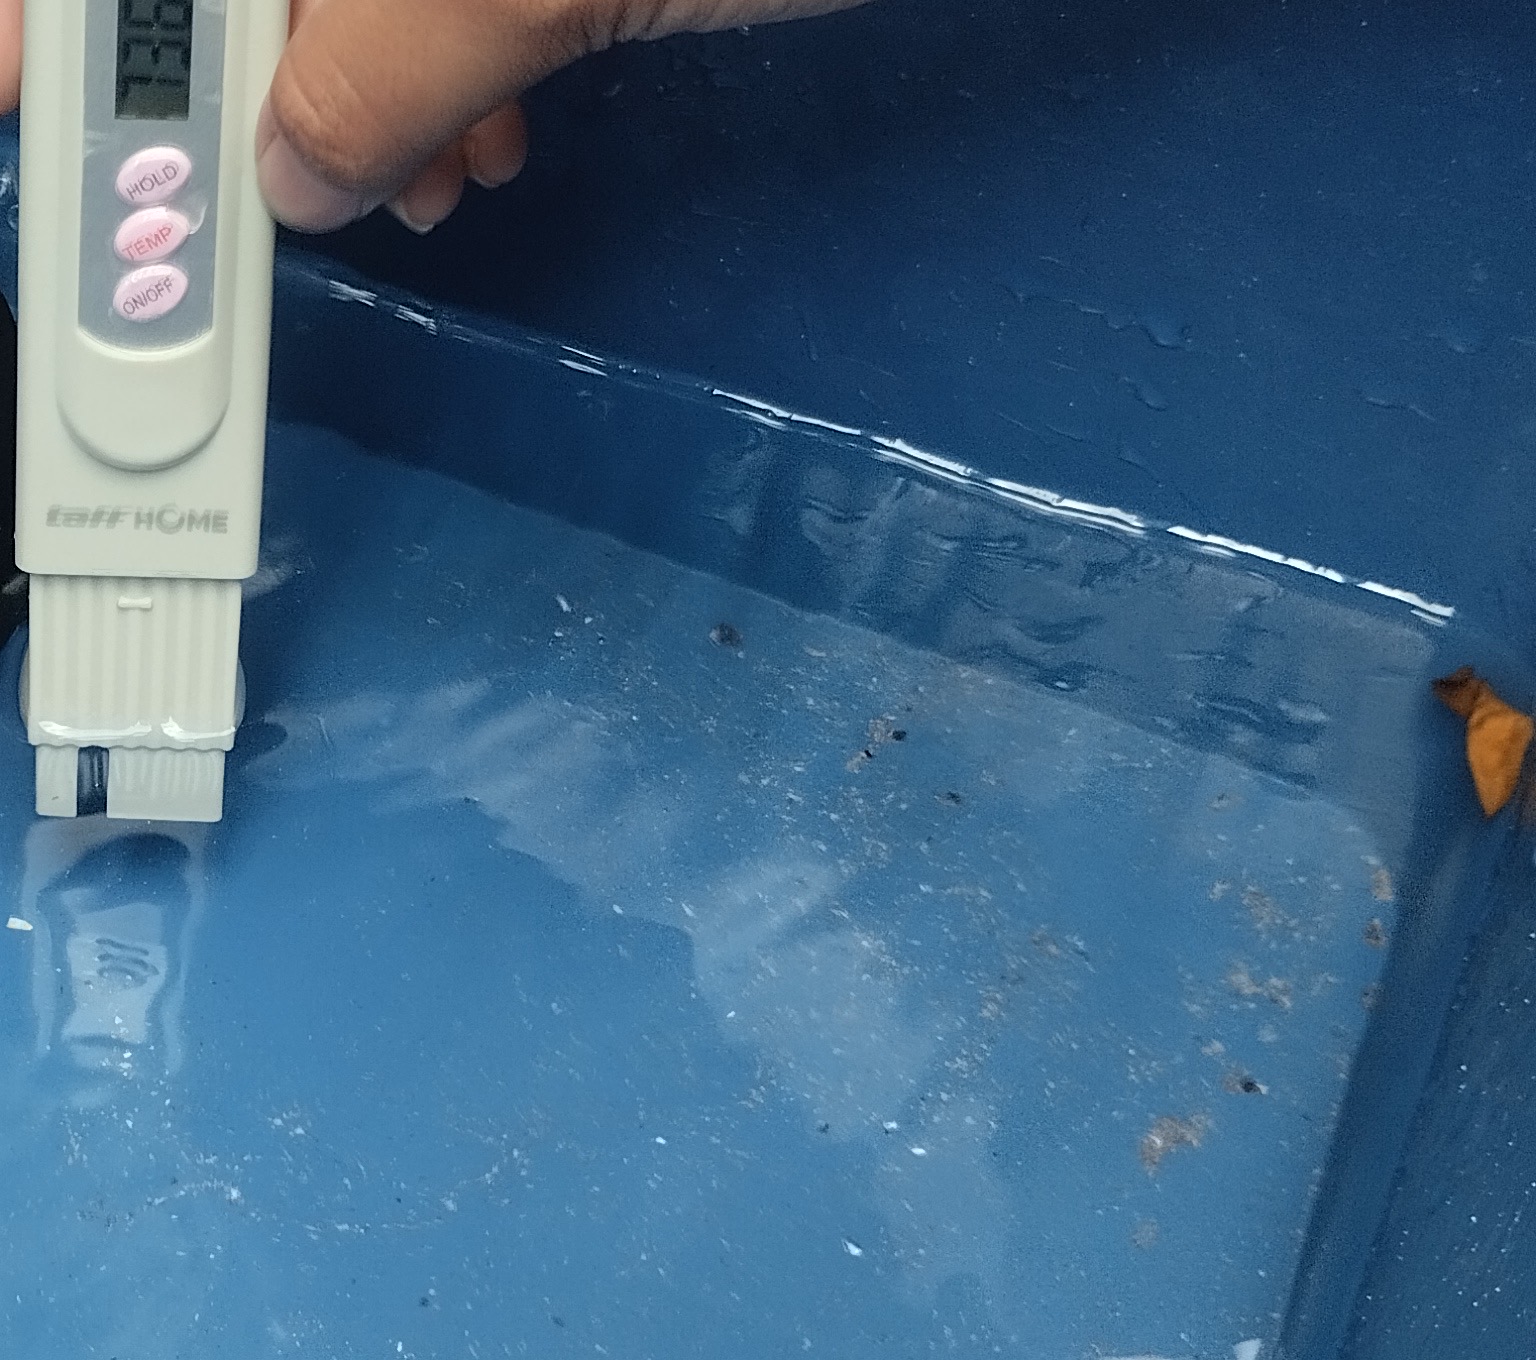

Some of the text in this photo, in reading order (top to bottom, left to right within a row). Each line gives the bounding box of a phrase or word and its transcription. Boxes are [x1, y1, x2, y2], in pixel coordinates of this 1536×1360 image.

[126, 163, 179, 200] HOLD
[122, 224, 173, 261] TEMP
[122, 276, 174, 315] ON/OFF
